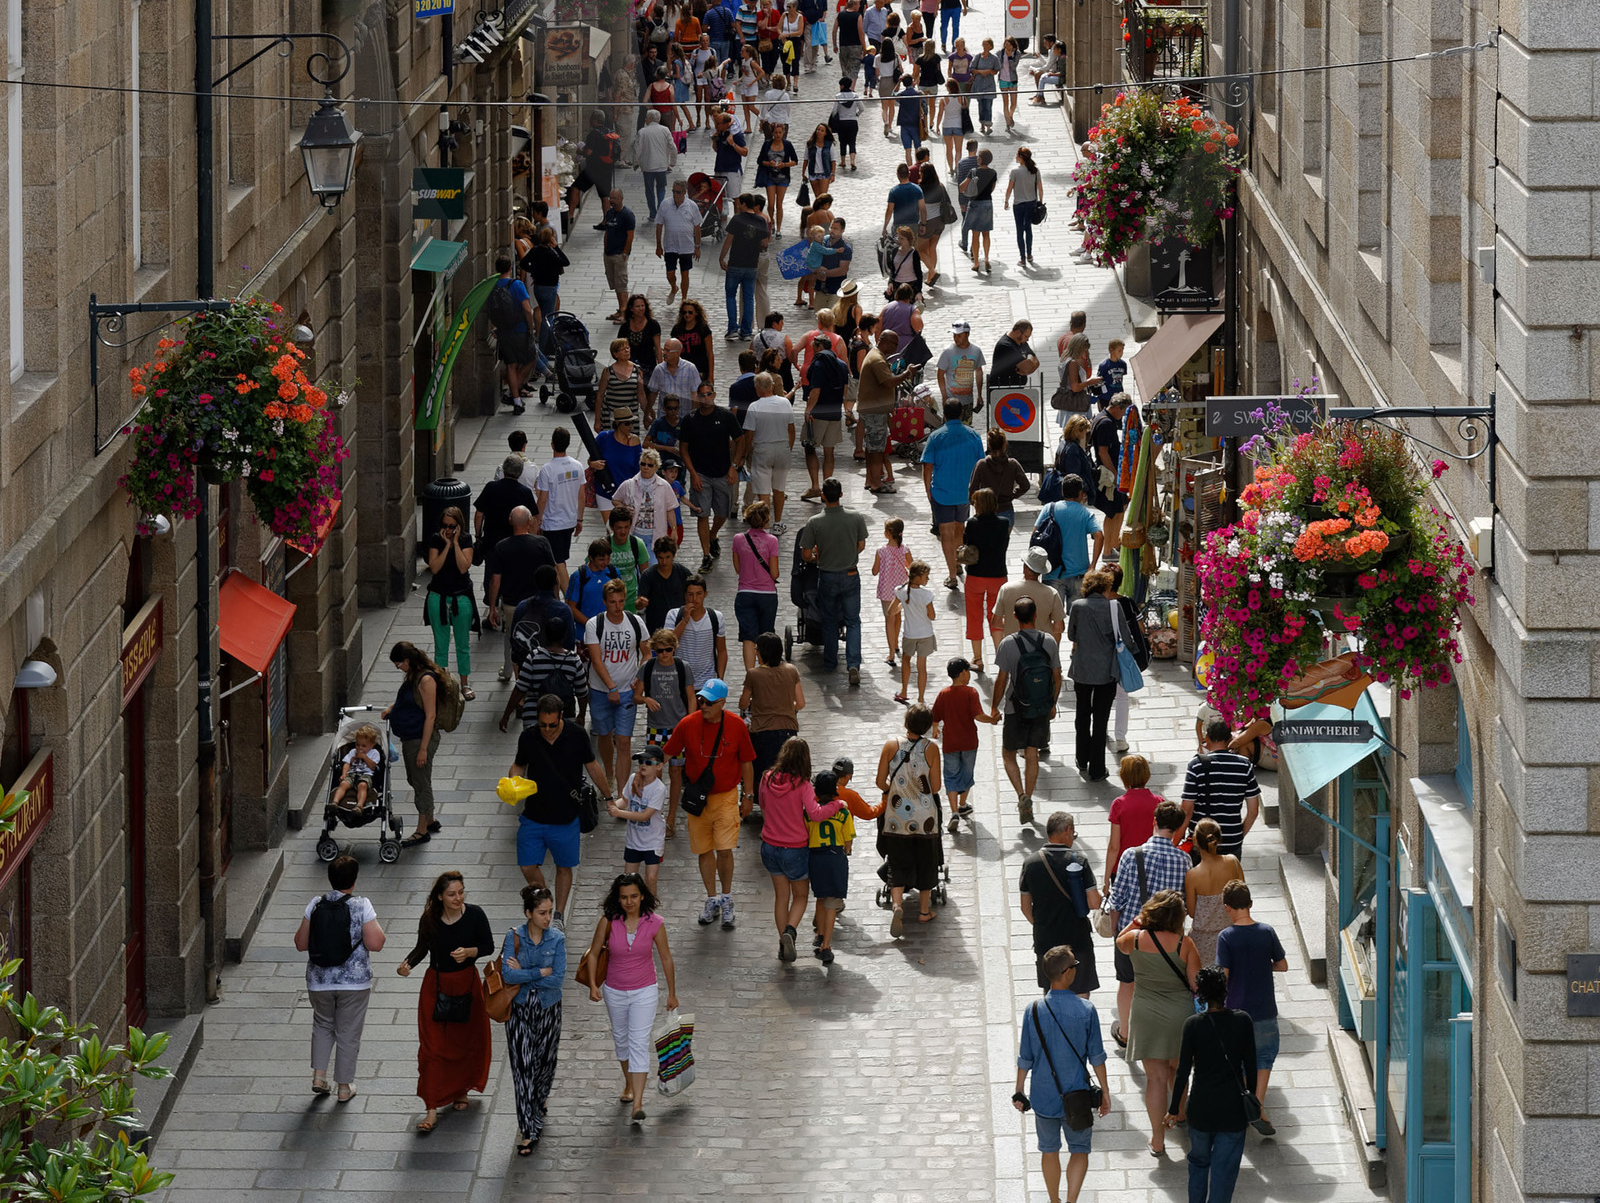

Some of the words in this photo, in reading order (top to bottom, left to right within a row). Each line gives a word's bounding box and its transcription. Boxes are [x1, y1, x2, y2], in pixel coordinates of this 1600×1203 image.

[418, 188, 461, 199] SUBWAY
[426, 307, 470, 418] SUBWAY
[605, 630, 631, 641] LET'S
[604, 639, 631, 650] HAVE
[603, 649, 630, 663] FUN
[1280, 725, 1360, 737] SANDWICHERIE
[819, 820, 836, 846] 9
